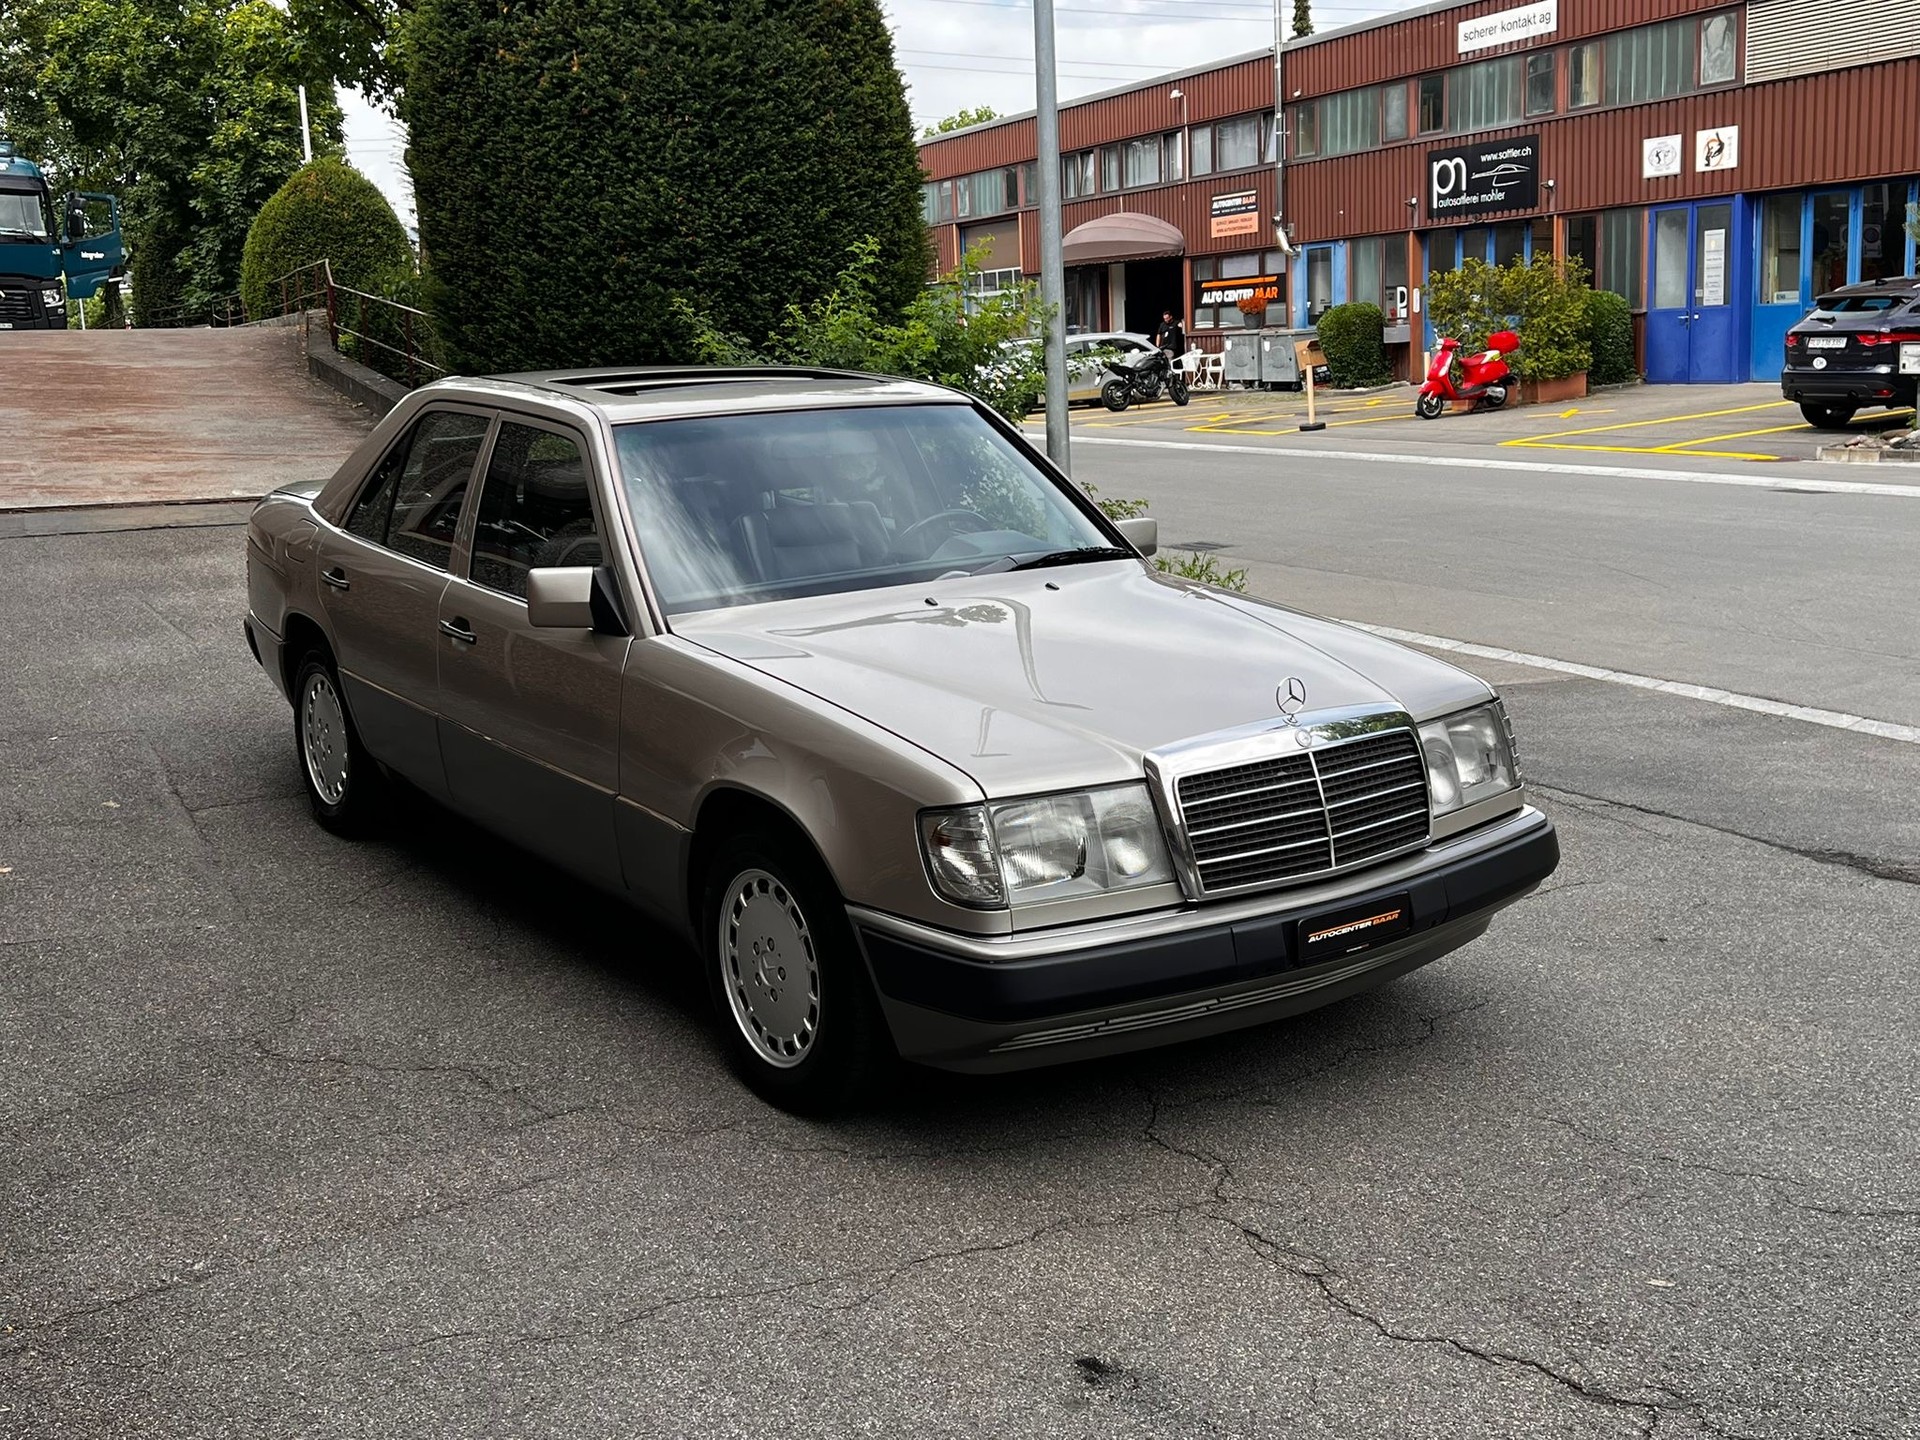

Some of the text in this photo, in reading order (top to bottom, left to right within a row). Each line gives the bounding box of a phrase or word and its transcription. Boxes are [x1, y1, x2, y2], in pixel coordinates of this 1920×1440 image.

[1463, 12, 1551, 41] scherer kontakt ag
[1480, 188, 1506, 203] mohler
[1201, 291, 1223, 304] AUTO
[1223, 288, 1254, 302] CENTER
[1307, 913, 1399, 943] AUTOCENTER BAAR
